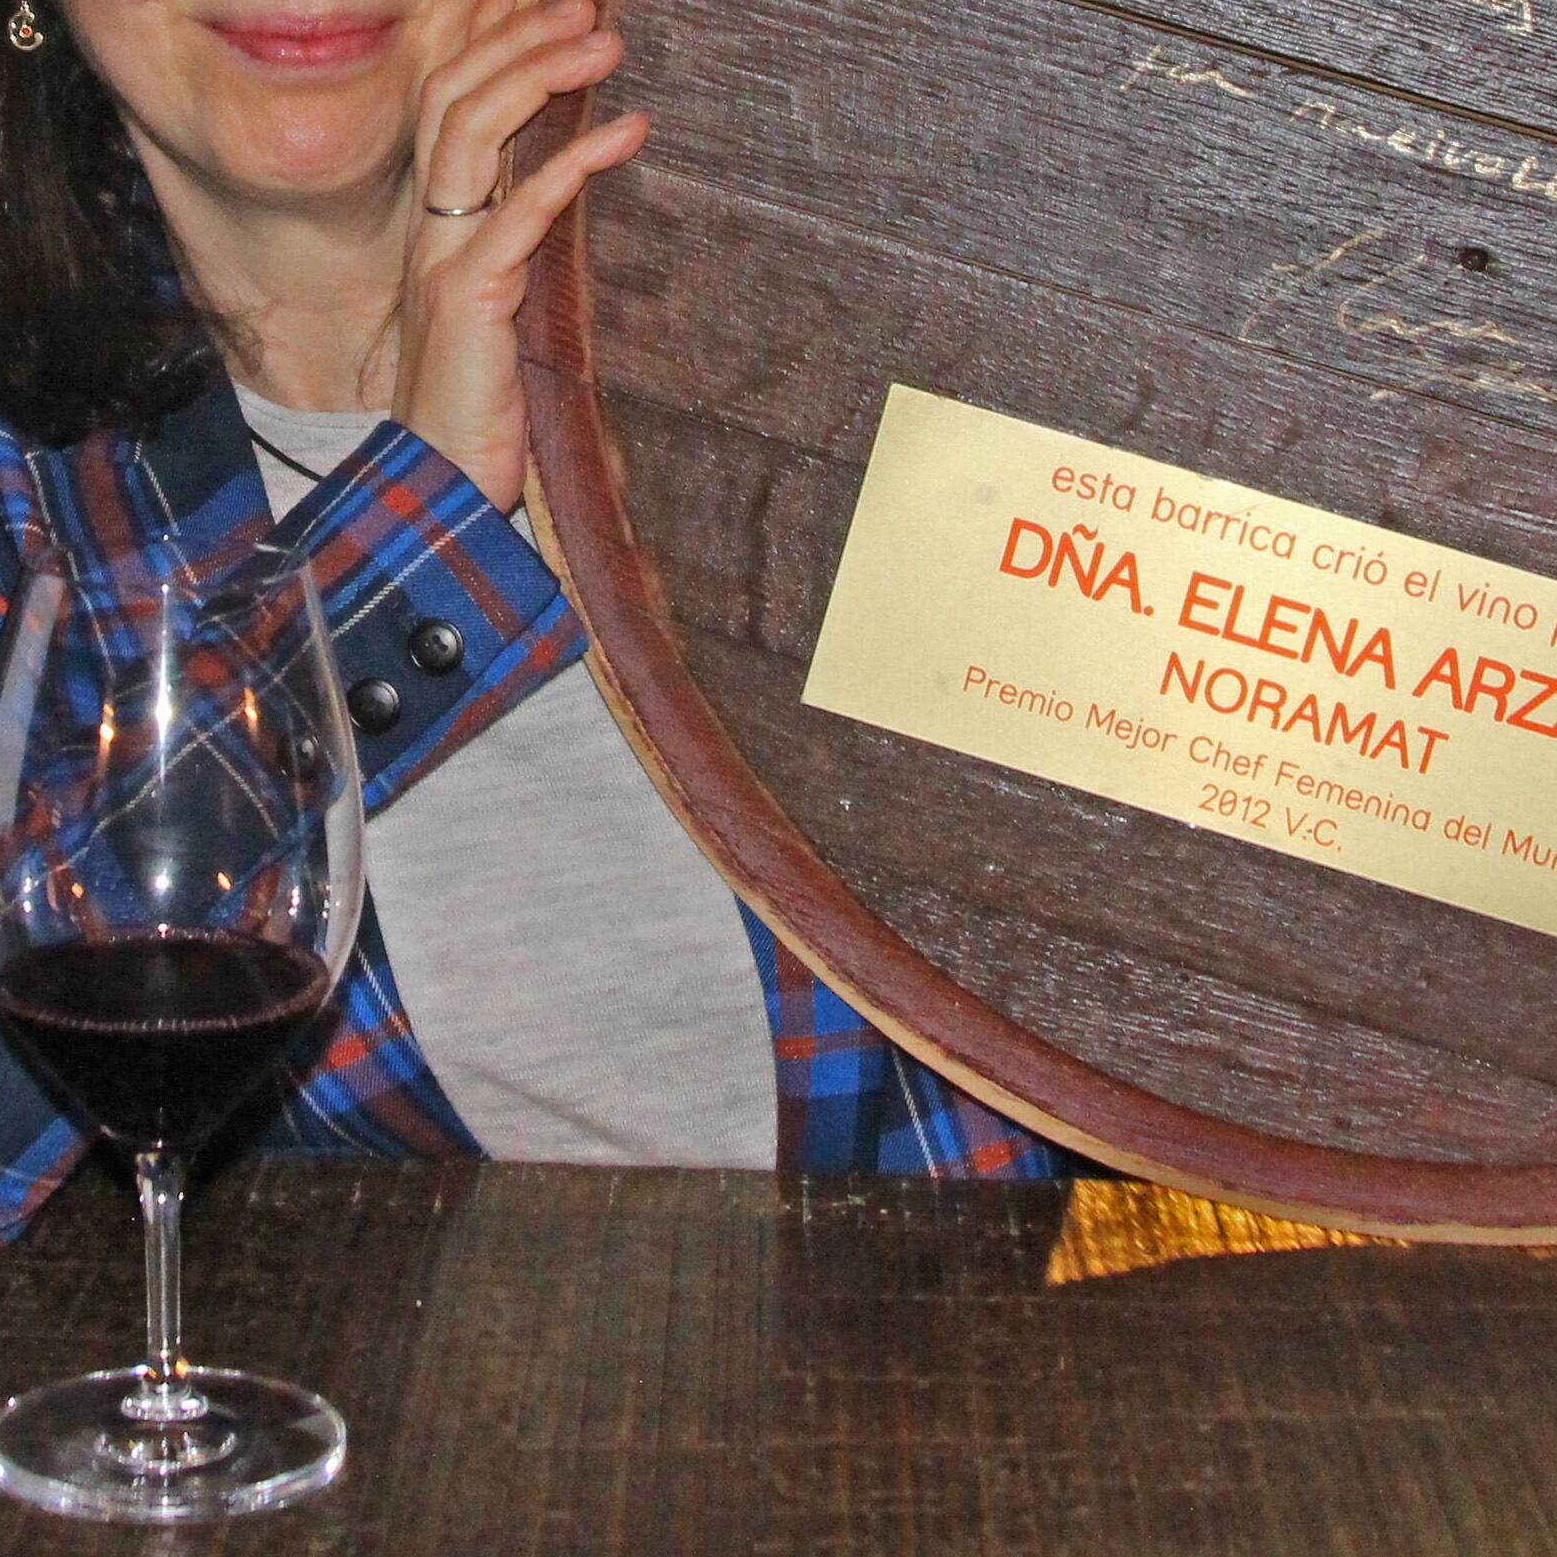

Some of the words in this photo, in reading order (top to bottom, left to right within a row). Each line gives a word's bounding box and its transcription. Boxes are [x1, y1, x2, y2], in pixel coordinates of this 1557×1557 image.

[999, 516, 1154, 617] DÑA.
[1178, 570, 1397, 691] ELENA
[1050, 459, 1138, 511] esta
[1151, 487, 1297, 559] barrica
[1310, 537, 1388, 585] crió
[1403, 567, 1440, 603] el
[1455, 580, 1539, 633] vino
[962, 665, 1075, 725] Premio
[1086, 701, 1178, 757] Mejor
[1189, 734, 1267, 782] Chef
[1274, 760, 1433, 831] Femenina
[1443, 811, 1491, 848] del
[1159, 651, 1450, 774] NORAMAT
[1197, 783, 1272, 829] 2012
